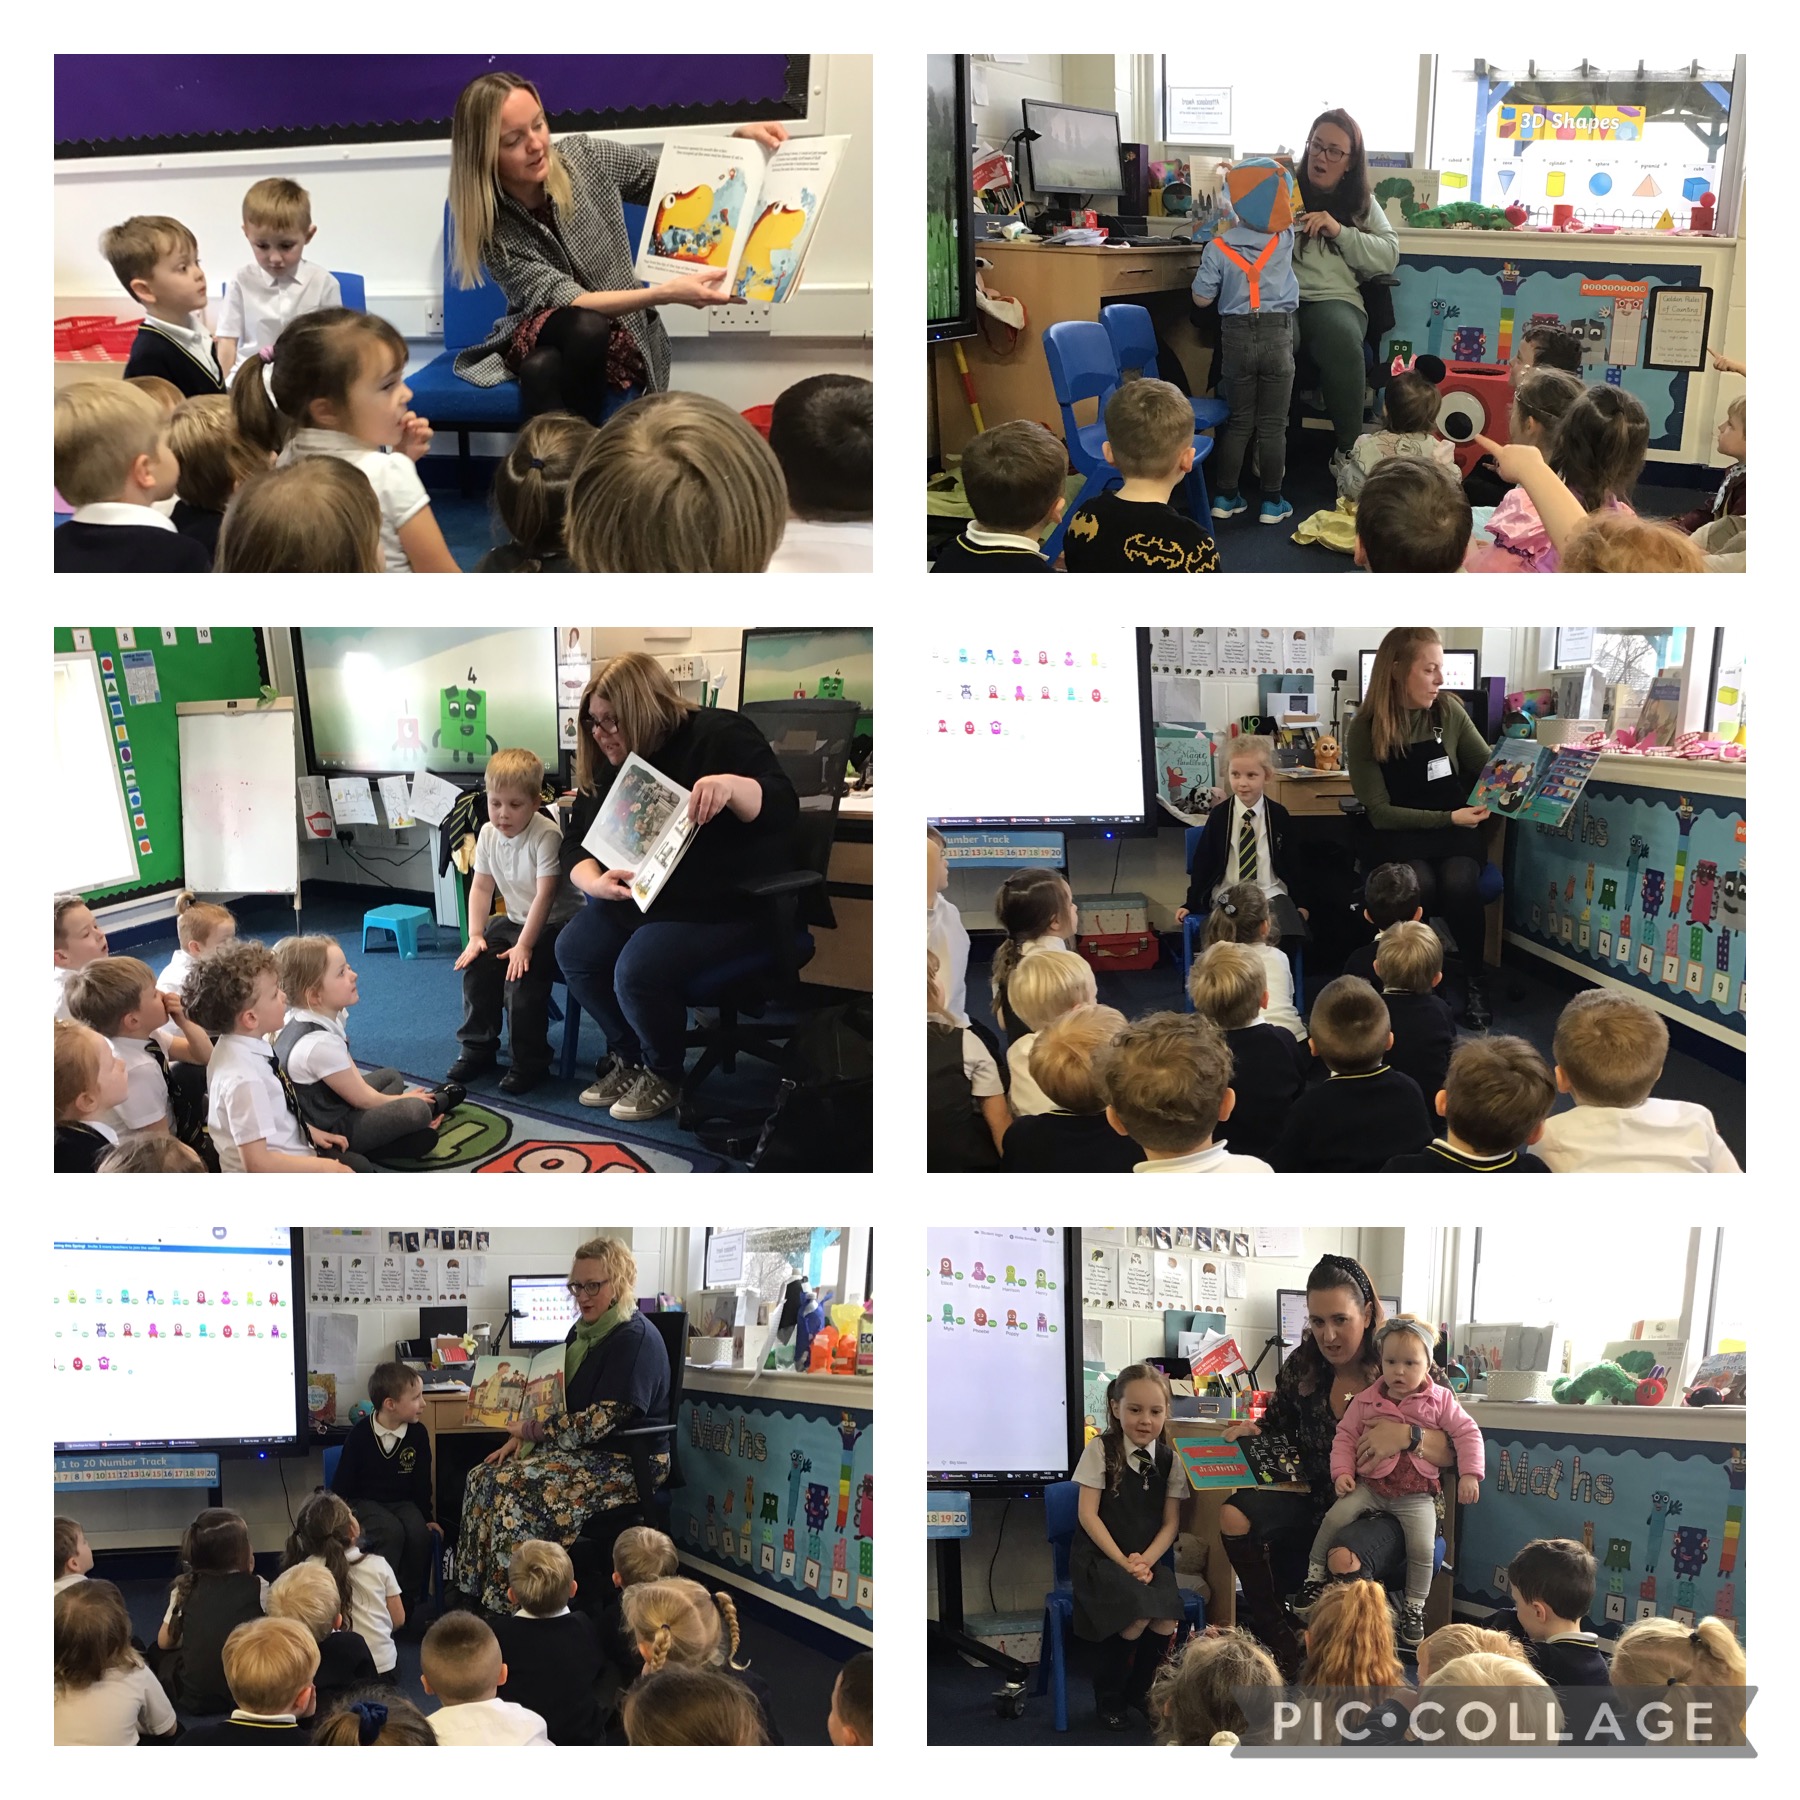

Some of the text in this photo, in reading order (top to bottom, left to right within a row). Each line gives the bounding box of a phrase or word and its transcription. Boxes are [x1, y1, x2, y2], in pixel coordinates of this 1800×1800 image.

[1520, 112, 1620, 135] 3D Shapes
[1672, 306, 1699, 314] Counting
[79, 630, 208, 644] 7 8 9 10
[467, 666, 477, 684] 4
[835, 668, 841, 676] 4
[1182, 750, 1207, 761] Magic
[944, 834, 1010, 844] umber Track
[948, 847, 1061, 857] 11 12 13 14 15 16 17 18 19 20
[1565, 924, 1569, 933] 2
[1582, 931, 1587, 940] 3
[1602, 940, 1607, 949] 4
[1621, 945, 1626, 954] 5
[1642, 954, 1648, 964] 6
[1668, 963, 1674, 973] 7
[1691, 972, 1697, 983] 8
[1718, 982, 1724, 993] 9
[691, 1409, 767, 1462] Maths
[70, 1460, 80, 1468] to
[83, 1459, 96, 1468] 20
[99, 1458, 138, 1467] Number
[141, 1457, 167, 1466] Track
[74, 1473, 80, 1481] 8
[119, 1471, 128, 1479] 12
[152, 1470, 162, 1478] 15
[163, 1470, 173, 1478] 16
[196, 1469, 206, 1477] 19
[206, 1469, 216, 1477] 20
[1497, 1449, 1615, 1505] Maths
[940, 1514, 951, 1523] 19
[954, 1514, 966, 1523] 20
[726, 1538, 731, 1546] 2
[743, 1545, 748, 1554] 3
[765, 1553, 770, 1562] 4
[786, 1558, 791, 1568] 5
[809, 1568, 814, 1578] 6
[837, 1578, 843, 1588] 7
[862, 1587, 868, 1598] 8
[1498, 1575, 1505, 1584] 0
[1612, 1602, 1619, 1613] 4
[1643, 1607, 1650, 1618] 5
